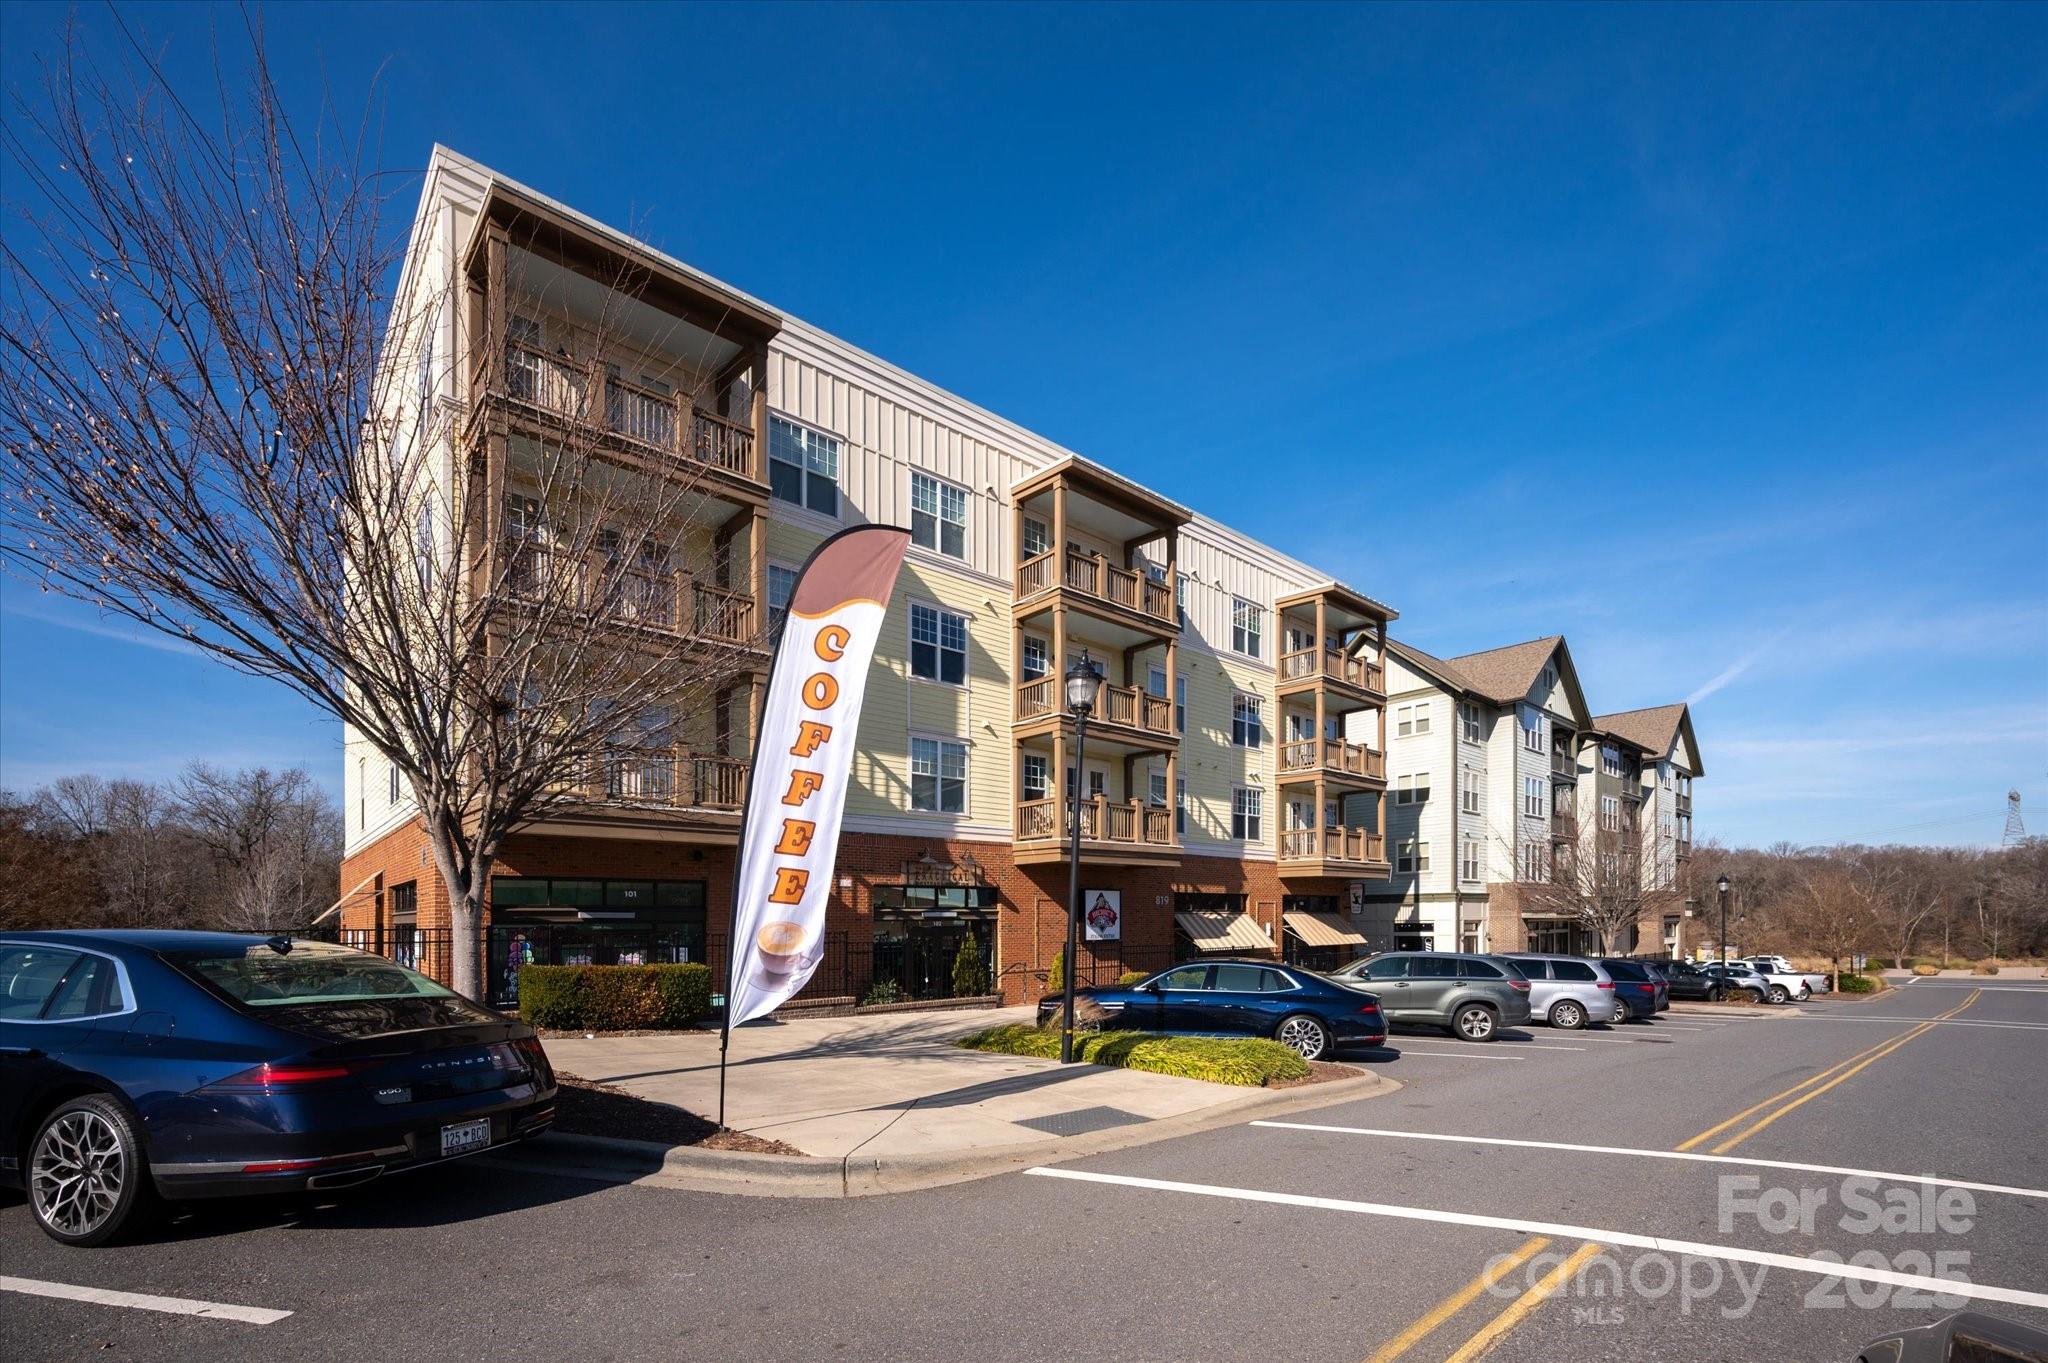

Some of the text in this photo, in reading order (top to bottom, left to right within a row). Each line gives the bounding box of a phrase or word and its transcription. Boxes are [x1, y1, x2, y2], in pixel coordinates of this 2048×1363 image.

[768, 623, 851, 905] COFFEE
[624, 890, 637, 898] 101
[1155, 895, 1169, 905] 819
[421, 1055, 501, 1069] GENESIS
[378, 1087, 402, 1095] G90
[445, 1131, 461, 1147] 125
